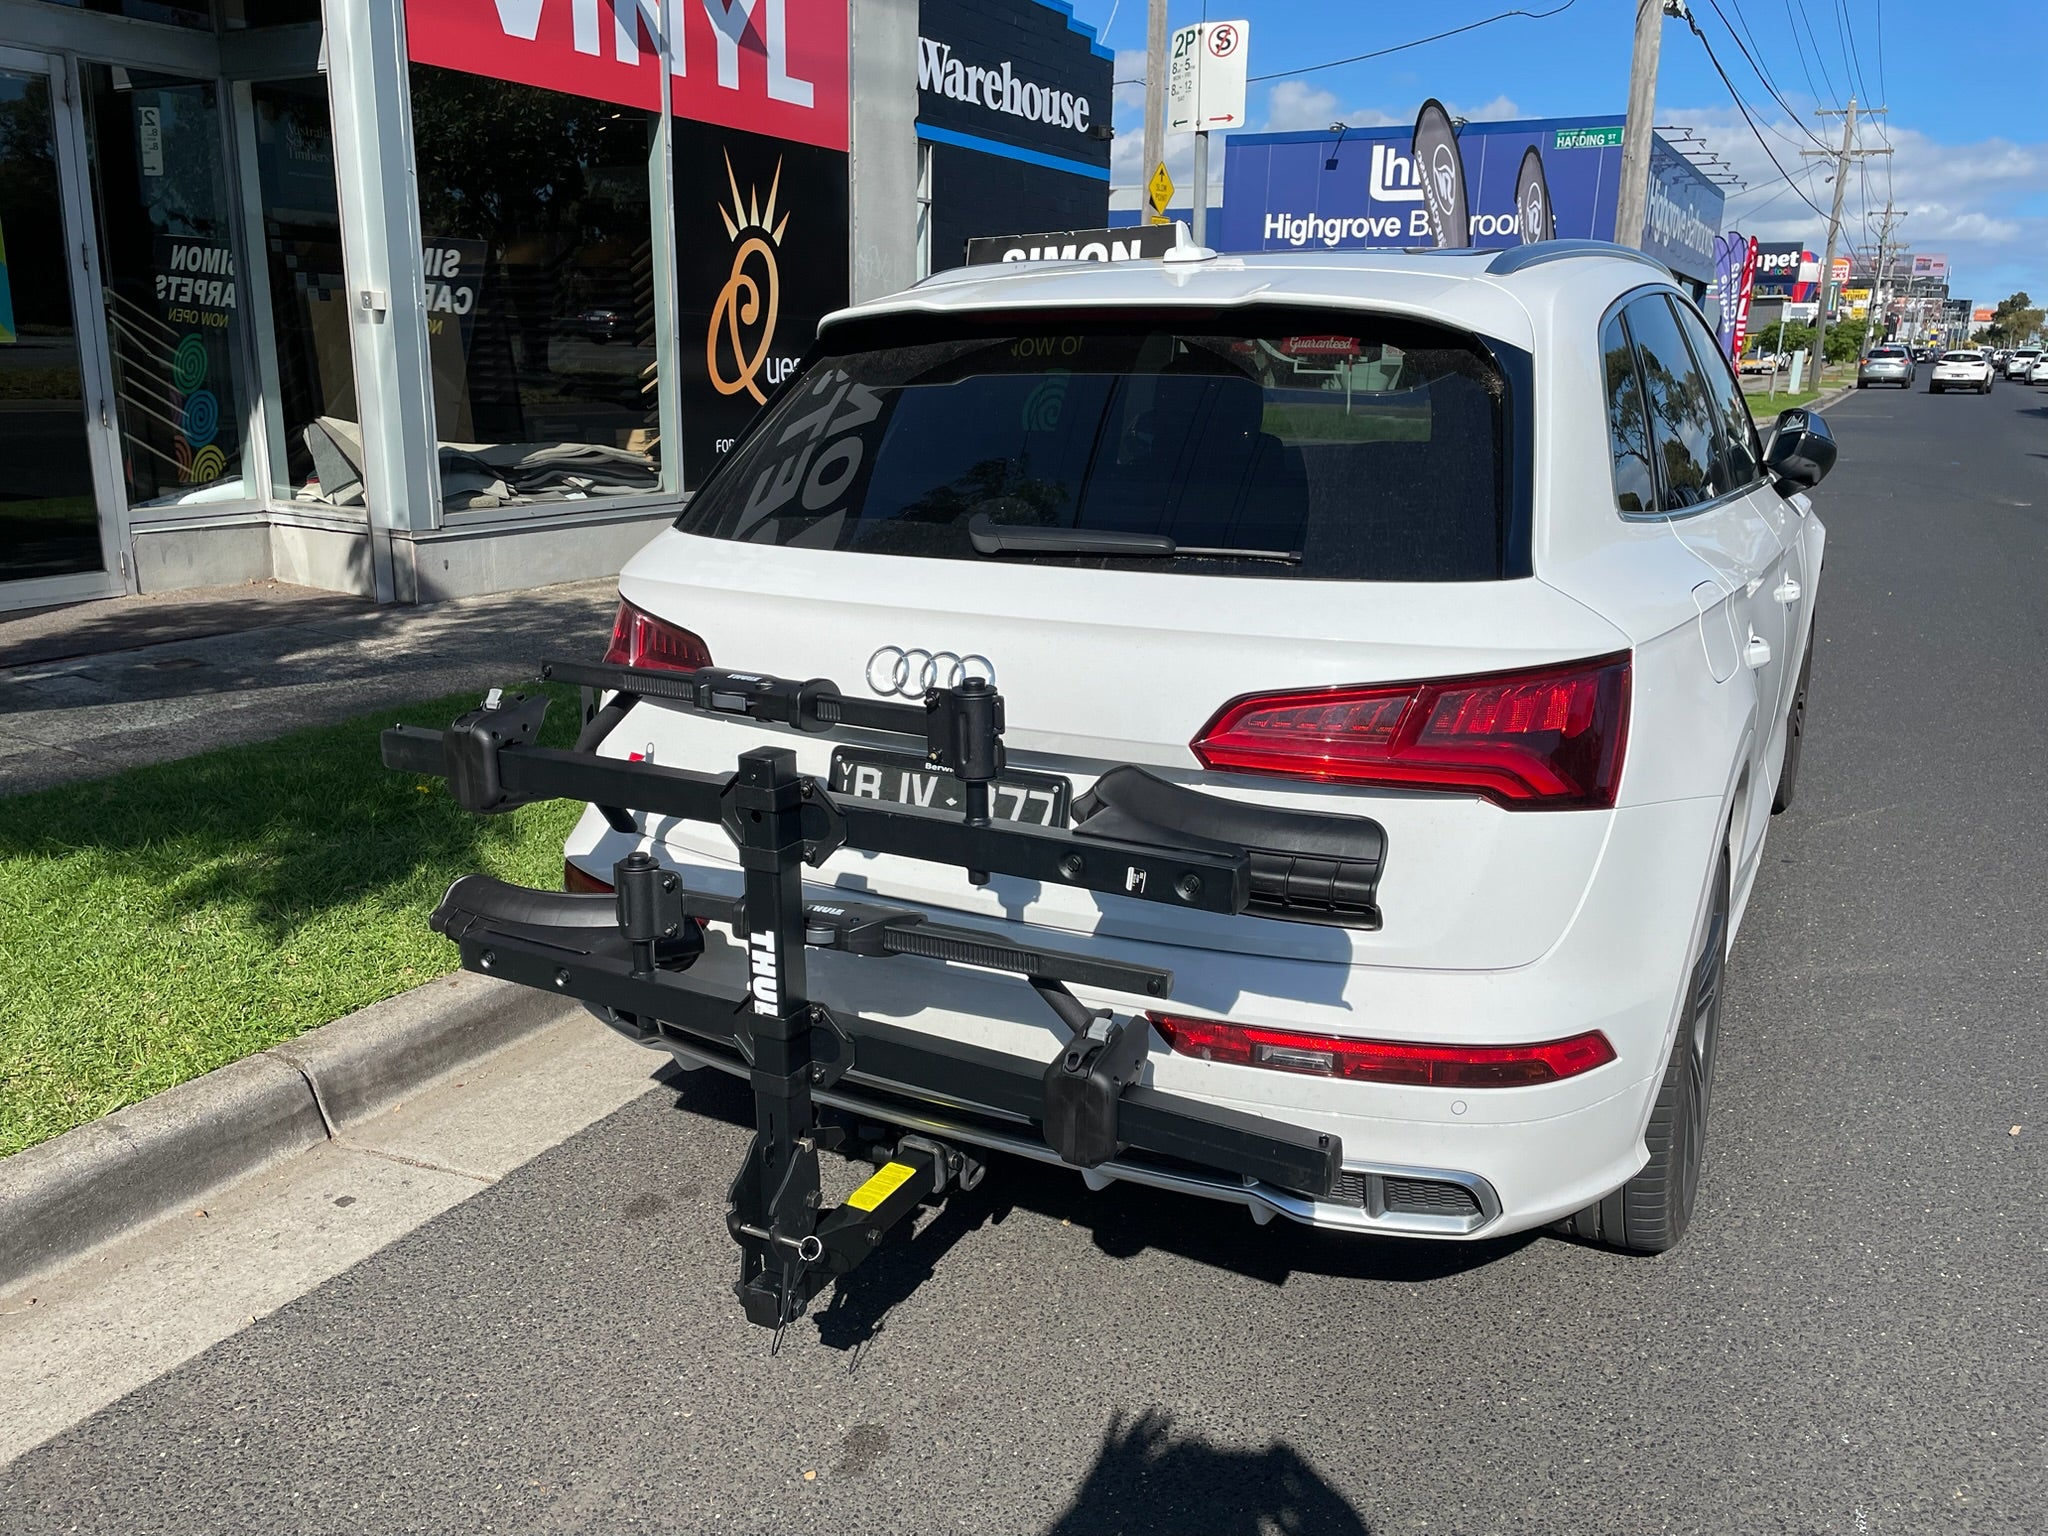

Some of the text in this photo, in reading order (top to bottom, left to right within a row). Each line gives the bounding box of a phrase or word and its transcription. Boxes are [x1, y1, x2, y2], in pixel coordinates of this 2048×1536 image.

[1174, 29, 1196, 59] 2P
[917, 36, 1090, 133] Warehouse
[1557, 135, 1605, 147] HARDING
[1264, 212, 1401, 246] Highgrove
[1769, 267, 1792, 276] stock
[1289, 336, 1353, 353] Guaranteed
[806, 904, 846, 916] THULE
